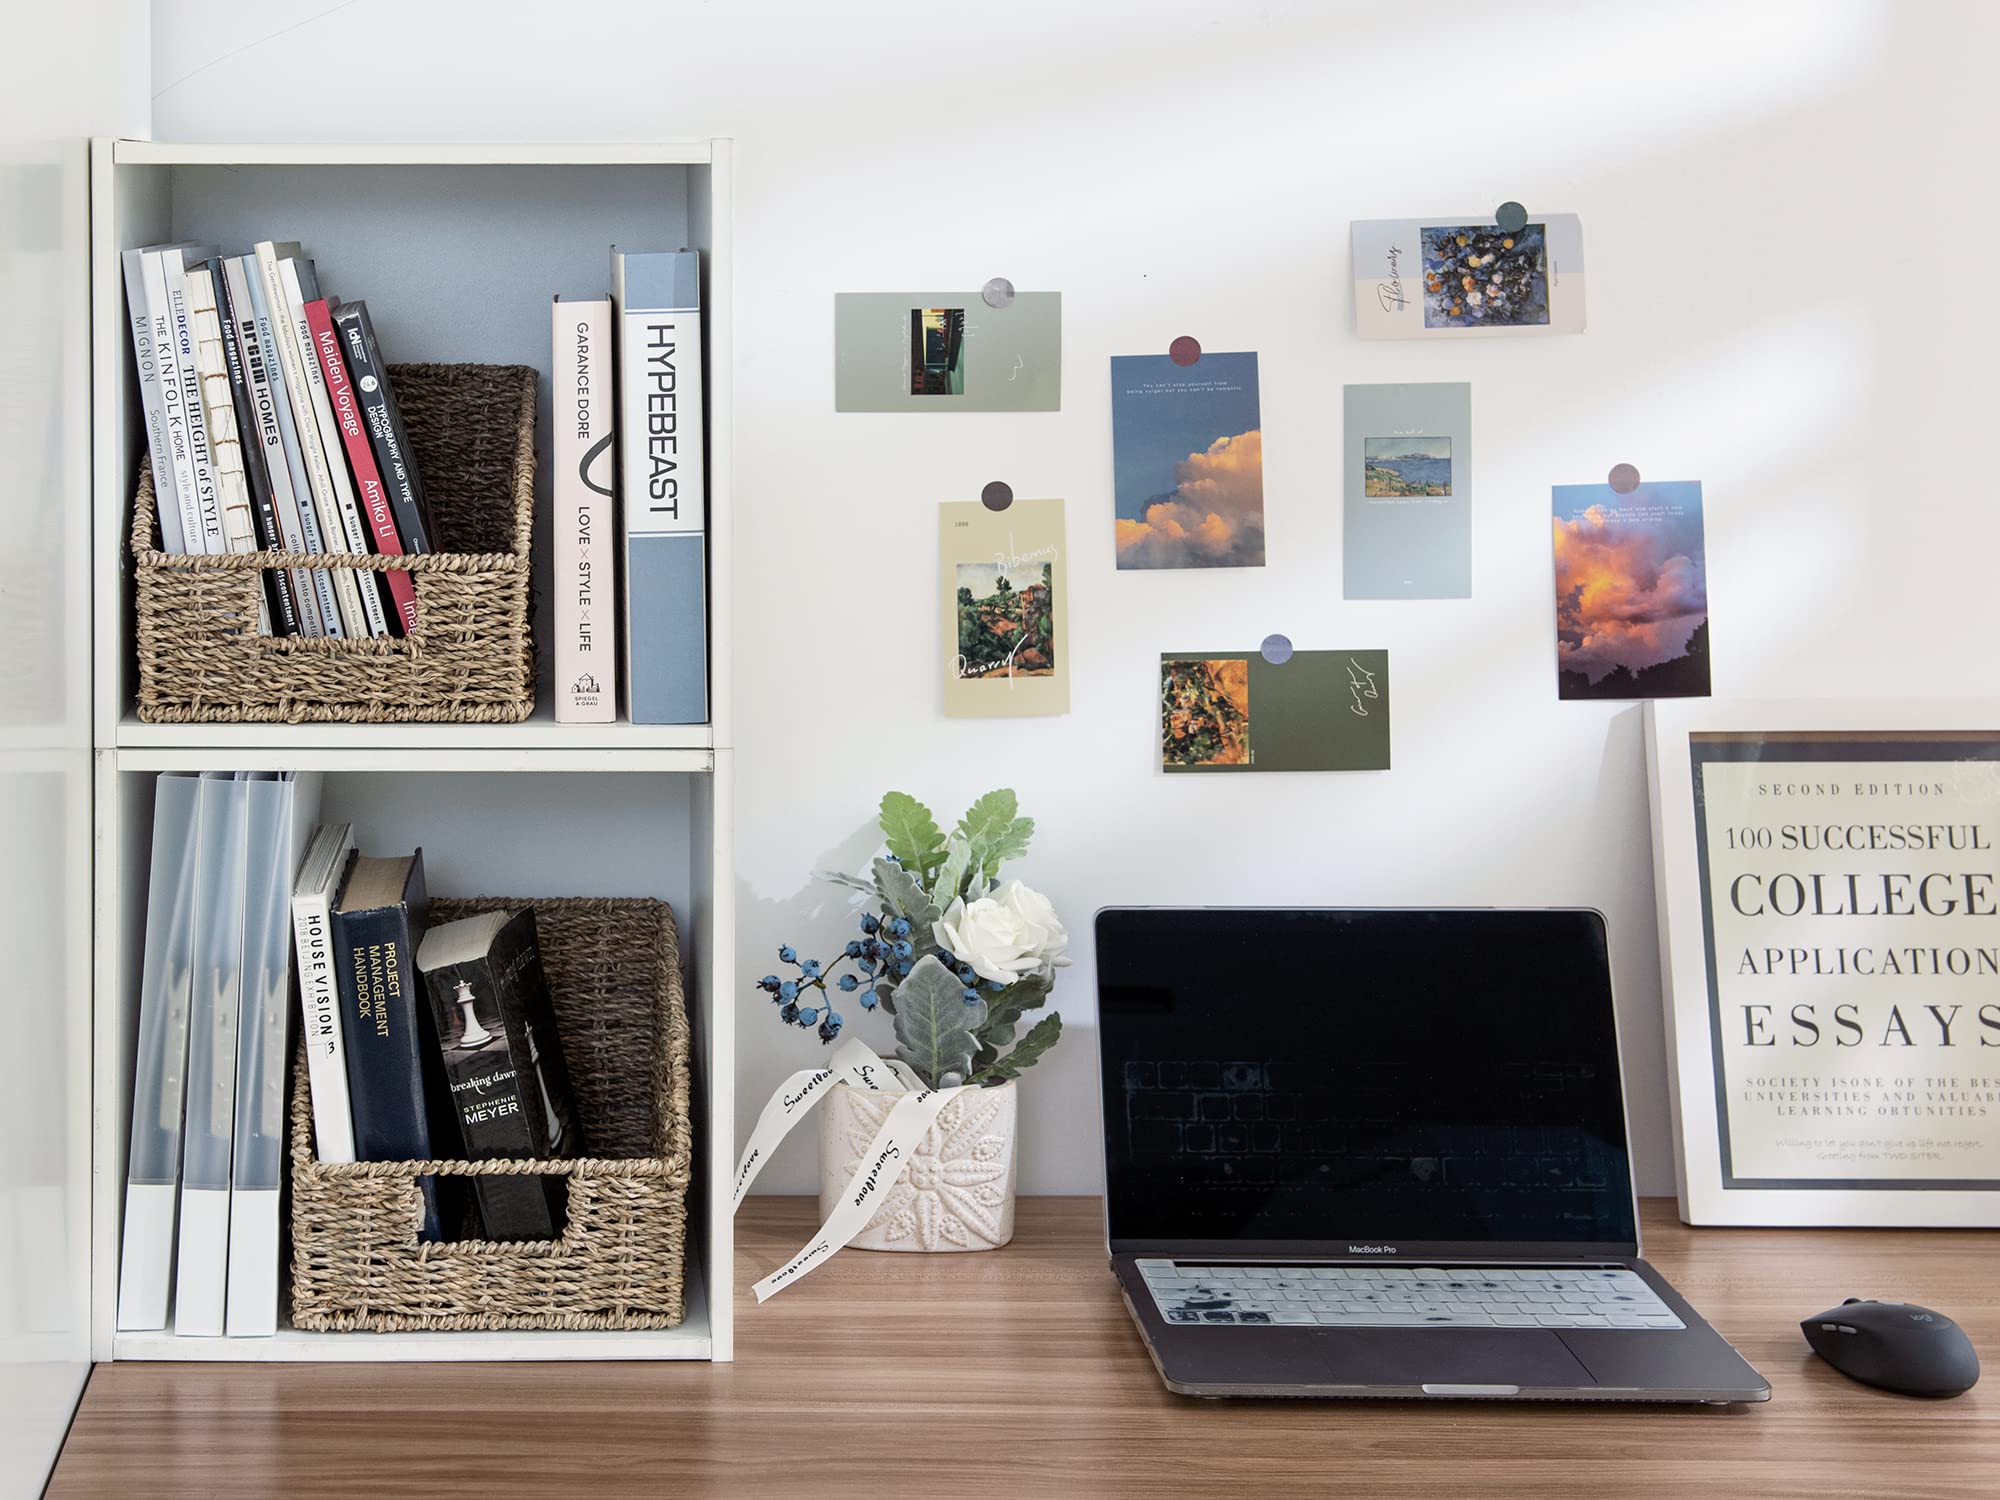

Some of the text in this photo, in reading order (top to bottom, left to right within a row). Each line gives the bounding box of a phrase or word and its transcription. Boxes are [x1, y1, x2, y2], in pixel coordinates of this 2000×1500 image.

[136, 316, 154, 382] MIGNON
[228, 342, 242, 384] magazines
[264, 339, 279, 382] magazines
[305, 342, 320, 384] magazines
[156, 316, 186, 461] THE KINFOLK HOME
[184, 366, 198, 399] THE
[577, 322, 590, 440] GARANCE DORE
[188, 401, 208, 464] HEIGHT
[256, 388, 278, 446] HOMES
[318, 331, 343, 384] Maiden
[336, 386, 358, 436] Voyage
[364, 480, 386, 523] Amiko
[380, 525, 394, 537] Li
[368, 406, 384, 438] DESIGN
[647, 324, 678, 520] HYPEBEAST
[150, 410, 168, 488] Southern France
[376, 404, 412, 503] TYPOGRAPHY AND TYPE
[198, 468, 212, 483] of
[201, 486, 220, 537] STYLE
[578, 506, 590, 545] LOVE
[579, 562, 591, 606] STYLE
[580, 623, 591, 652] LIFE
[1758, 783, 1945, 796] SECOND EDITION
[1726, 824, 1991, 850] 100 SUCCESSFUL
[1730, 873, 1998, 916] COLLEGE
[298, 917, 320, 1038] 2018 BEIJING EXHIBITION
[308, 916, 332, 1036] HOUSE VISION
[354, 947, 372, 1018] HANDBOOK
[384, 942, 400, 998] PROJECT
[1737, 947, 2000, 975] APPLICATION
[368, 945, 389, 1038] MANAGEMENT
[1740, 1004, 2000, 1047] ESSAYS
[328, 1041, 334, 1054] 3
[450, 1069, 518, 1095] breaking dawn
[464, 1094, 517, 1113] STEPHENIE
[1744, 1092, 1872, 1102] UNIVERSITIES
[1882, 1092, 1916, 1102] AND
[1746, 1078, 1821, 1088] SOCIETY
[1894, 1078, 1916, 1088] OF
[1925, 1078, 1960, 1088] THE
[466, 1102, 519, 1125] MEYER
[1777, 1106, 1868, 1116] LEARNING
[854, 1140, 900, 1206] Sweetlove
[771, 1240, 829, 1284] Sweetlove
[1348, 1246, 1397, 1254] MacBook Pro
